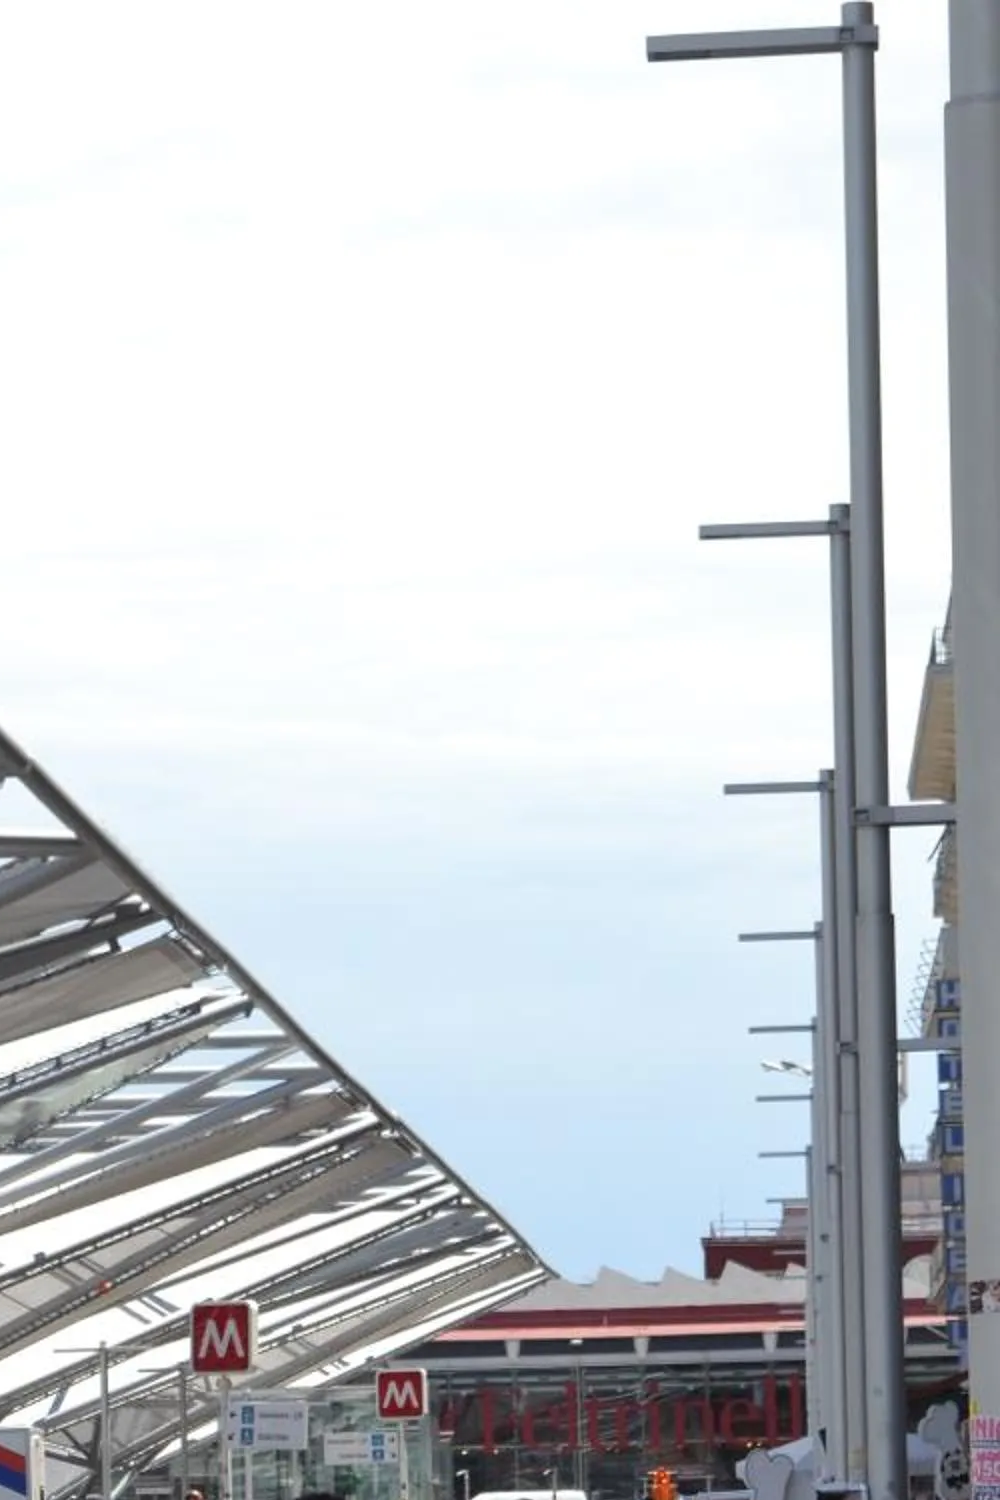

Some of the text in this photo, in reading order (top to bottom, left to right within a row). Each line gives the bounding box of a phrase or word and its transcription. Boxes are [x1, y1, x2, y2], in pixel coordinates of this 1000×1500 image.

[198, 1317, 246, 1359] M
[382, 1380, 419, 1409] M
[475, 1372, 804, 1457] Feltrinell
